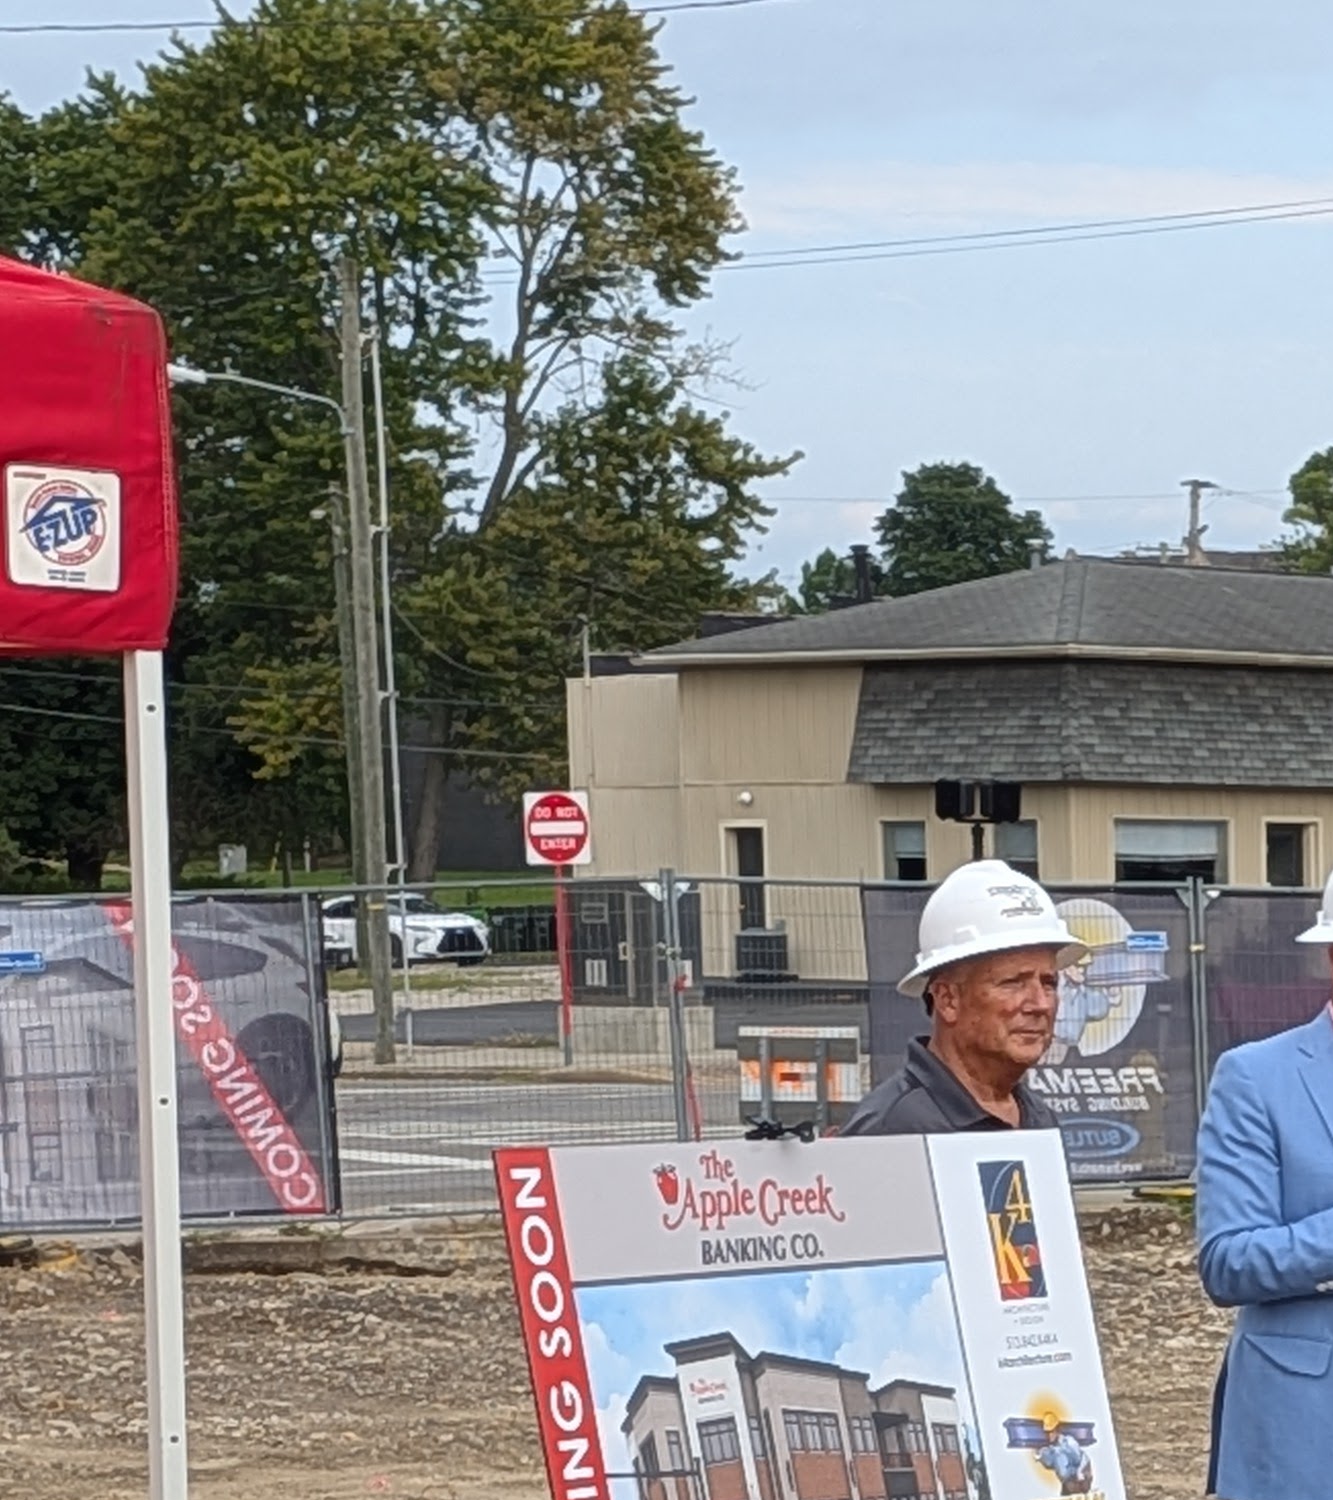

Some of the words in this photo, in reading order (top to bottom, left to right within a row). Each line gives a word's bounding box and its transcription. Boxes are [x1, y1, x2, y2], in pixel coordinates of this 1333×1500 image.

[534, 806, 552, 819] DO
[555, 806, 578, 818] NOT
[540, 838, 576, 850] ENTER
[700, 1149, 735, 1182] The
[663, 1178, 756, 1231] Apple
[759, 1174, 846, 1226] Creek
[510, 1167, 572, 1359] SOON
[702, 1235, 787, 1265] BANKING
[791, 1233, 824, 1259] CO.
